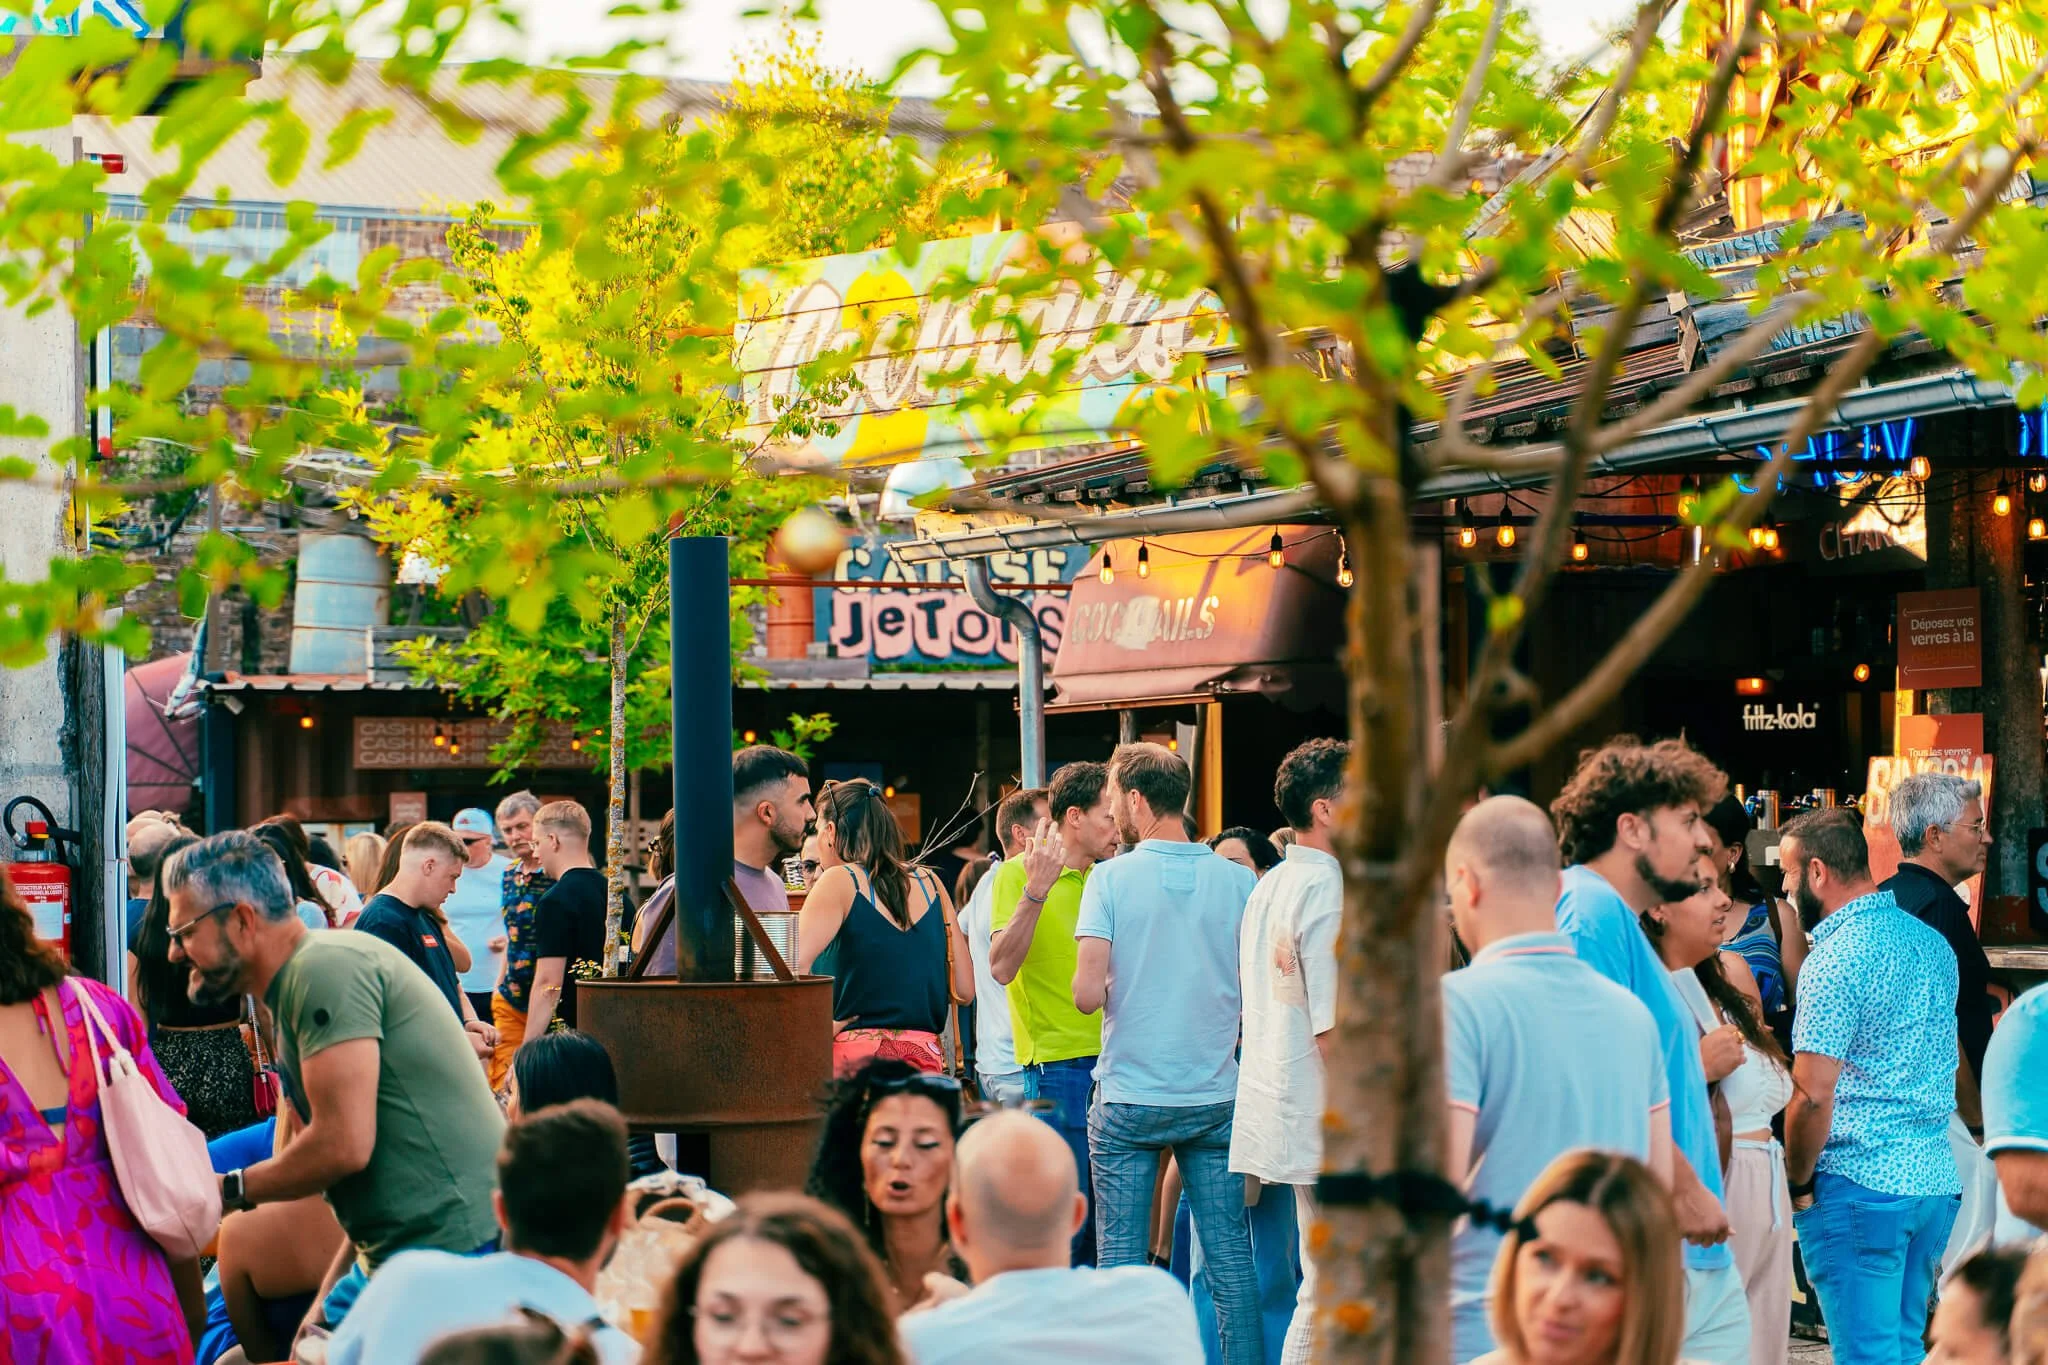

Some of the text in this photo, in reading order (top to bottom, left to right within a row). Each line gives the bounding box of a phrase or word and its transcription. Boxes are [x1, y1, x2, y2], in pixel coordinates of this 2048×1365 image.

[1681, 226, 1787, 270] WHISK
[1769, 310, 1875, 350] WHISK
[834, 548, 1069, 596] CAISE
[1071, 595, 1220, 644] COCAILS
[1911, 617, 1975, 632] Déposez vos
[1911, 628, 1976, 646] verres à la
[1742, 702, 1817, 731] fritz-kola
[360, 722, 416, 736] CASH
[360, 737, 416, 750] CASH
[360, 751, 416, 765] CASH
